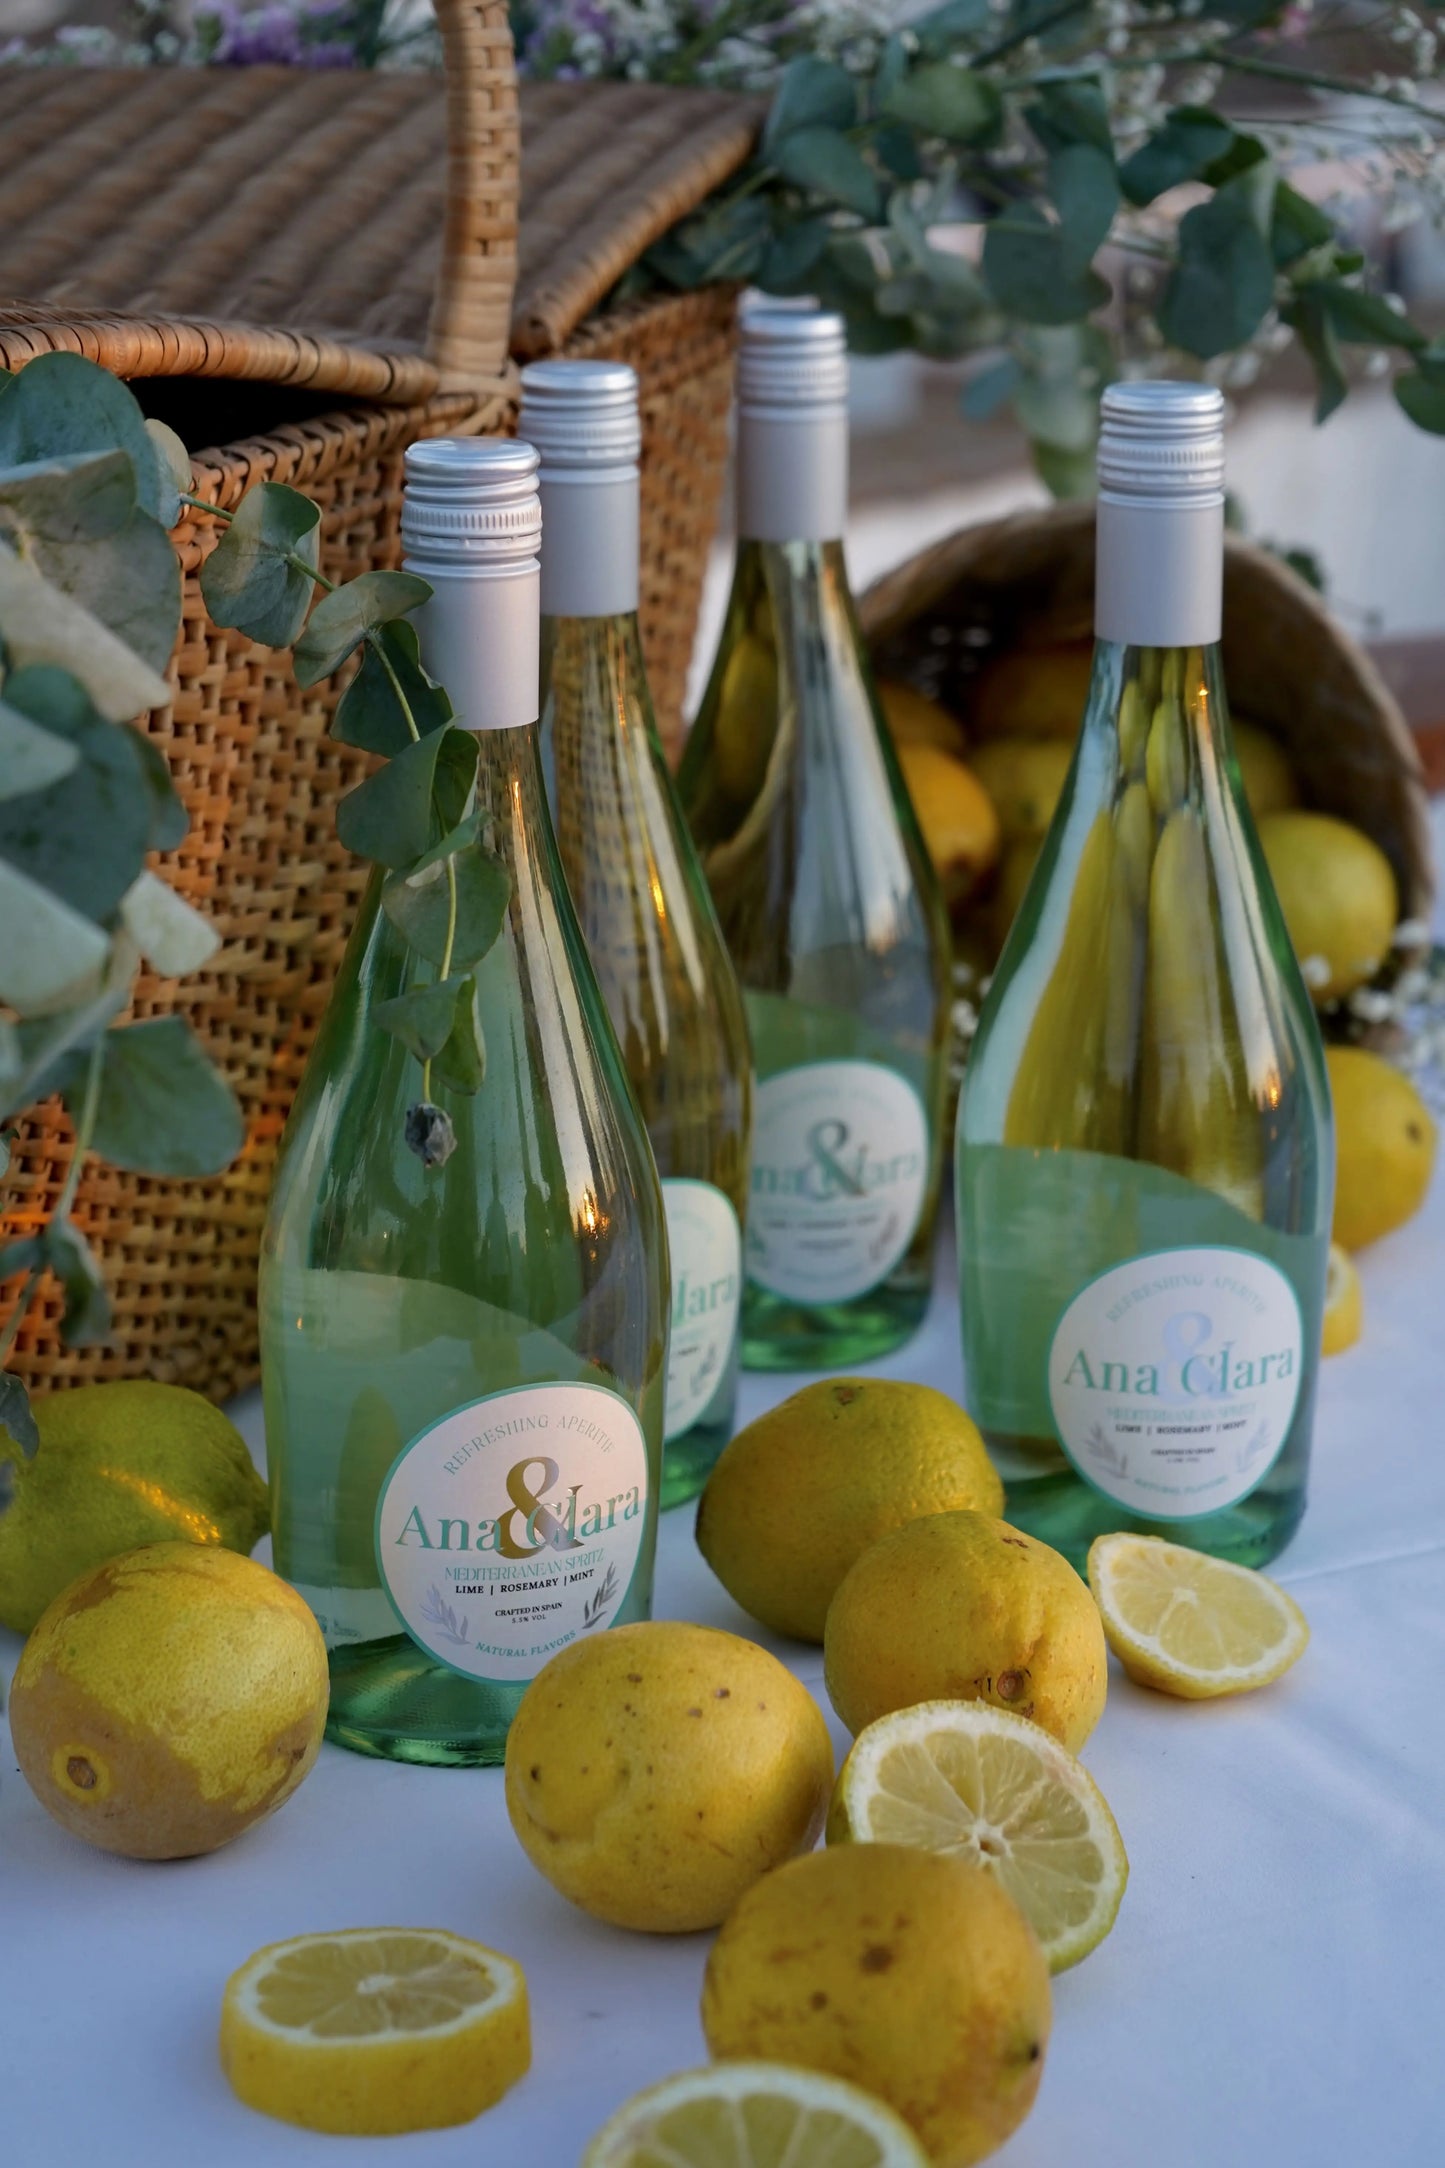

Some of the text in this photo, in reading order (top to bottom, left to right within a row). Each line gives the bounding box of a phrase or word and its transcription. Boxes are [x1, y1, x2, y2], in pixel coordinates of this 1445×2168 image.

[1063, 1348, 1160, 1396] Ana
[1180, 1346, 1294, 1397] Clara
[443, 1414, 616, 1476] REFRESHING APERITIF
[395, 1456, 640, 1560] Ana & Clara
[445, 1548, 605, 1582] MEDITERRANEAN SPRITZ
[455, 1585, 485, 1595] LIME
[500, 1577, 559, 1593] ROSEMARY
[569, 1569, 595, 1584] MINT
[495, 1602, 564, 1617] CRAFTED IN SPAIN
[532, 1613, 547, 1622] VOL
[475, 1630, 577, 1657] NATURAL FLAVORS
